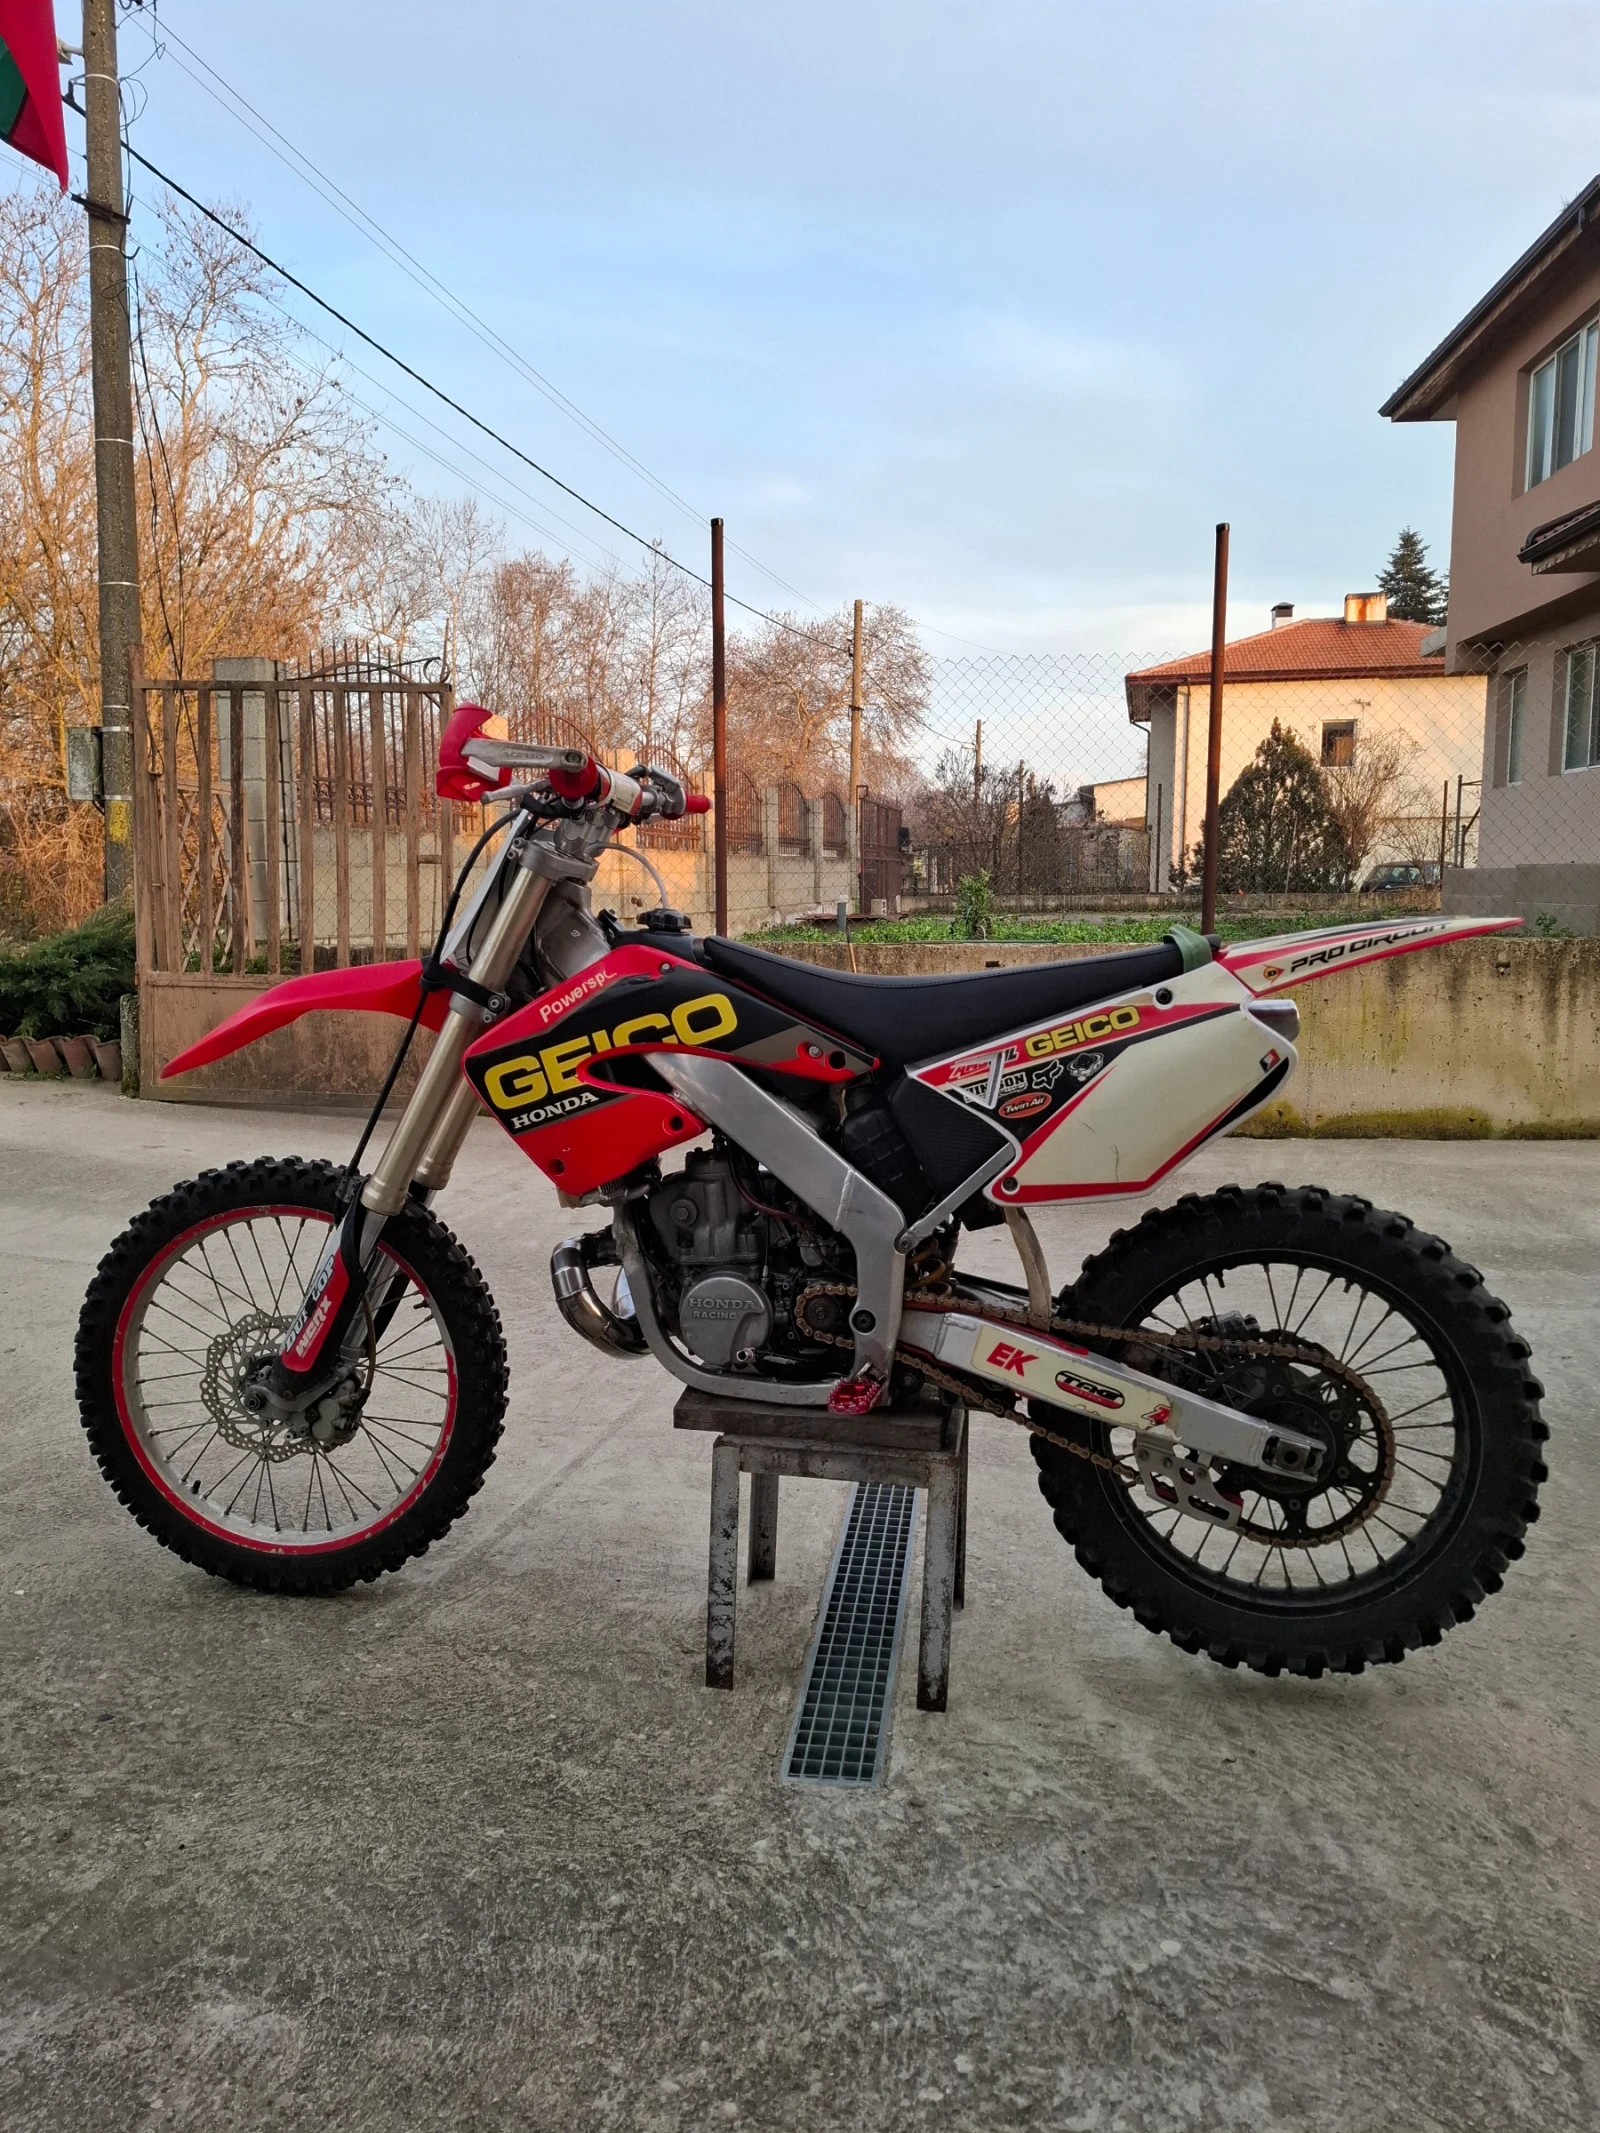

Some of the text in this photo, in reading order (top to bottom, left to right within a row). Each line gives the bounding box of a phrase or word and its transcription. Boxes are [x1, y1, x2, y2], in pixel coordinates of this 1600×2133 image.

[1290, 944, 1345, 973] PRO
[1025, 1005, 1141, 1058] GEICO
[511, 1091, 599, 1129] HONDA
[1005, 1095, 1045, 1114] Twin Air
[688, 1298, 758, 1310] HONDA
[693, 1310, 737, 1320] RACING
[986, 1342, 1039, 1376] EK
